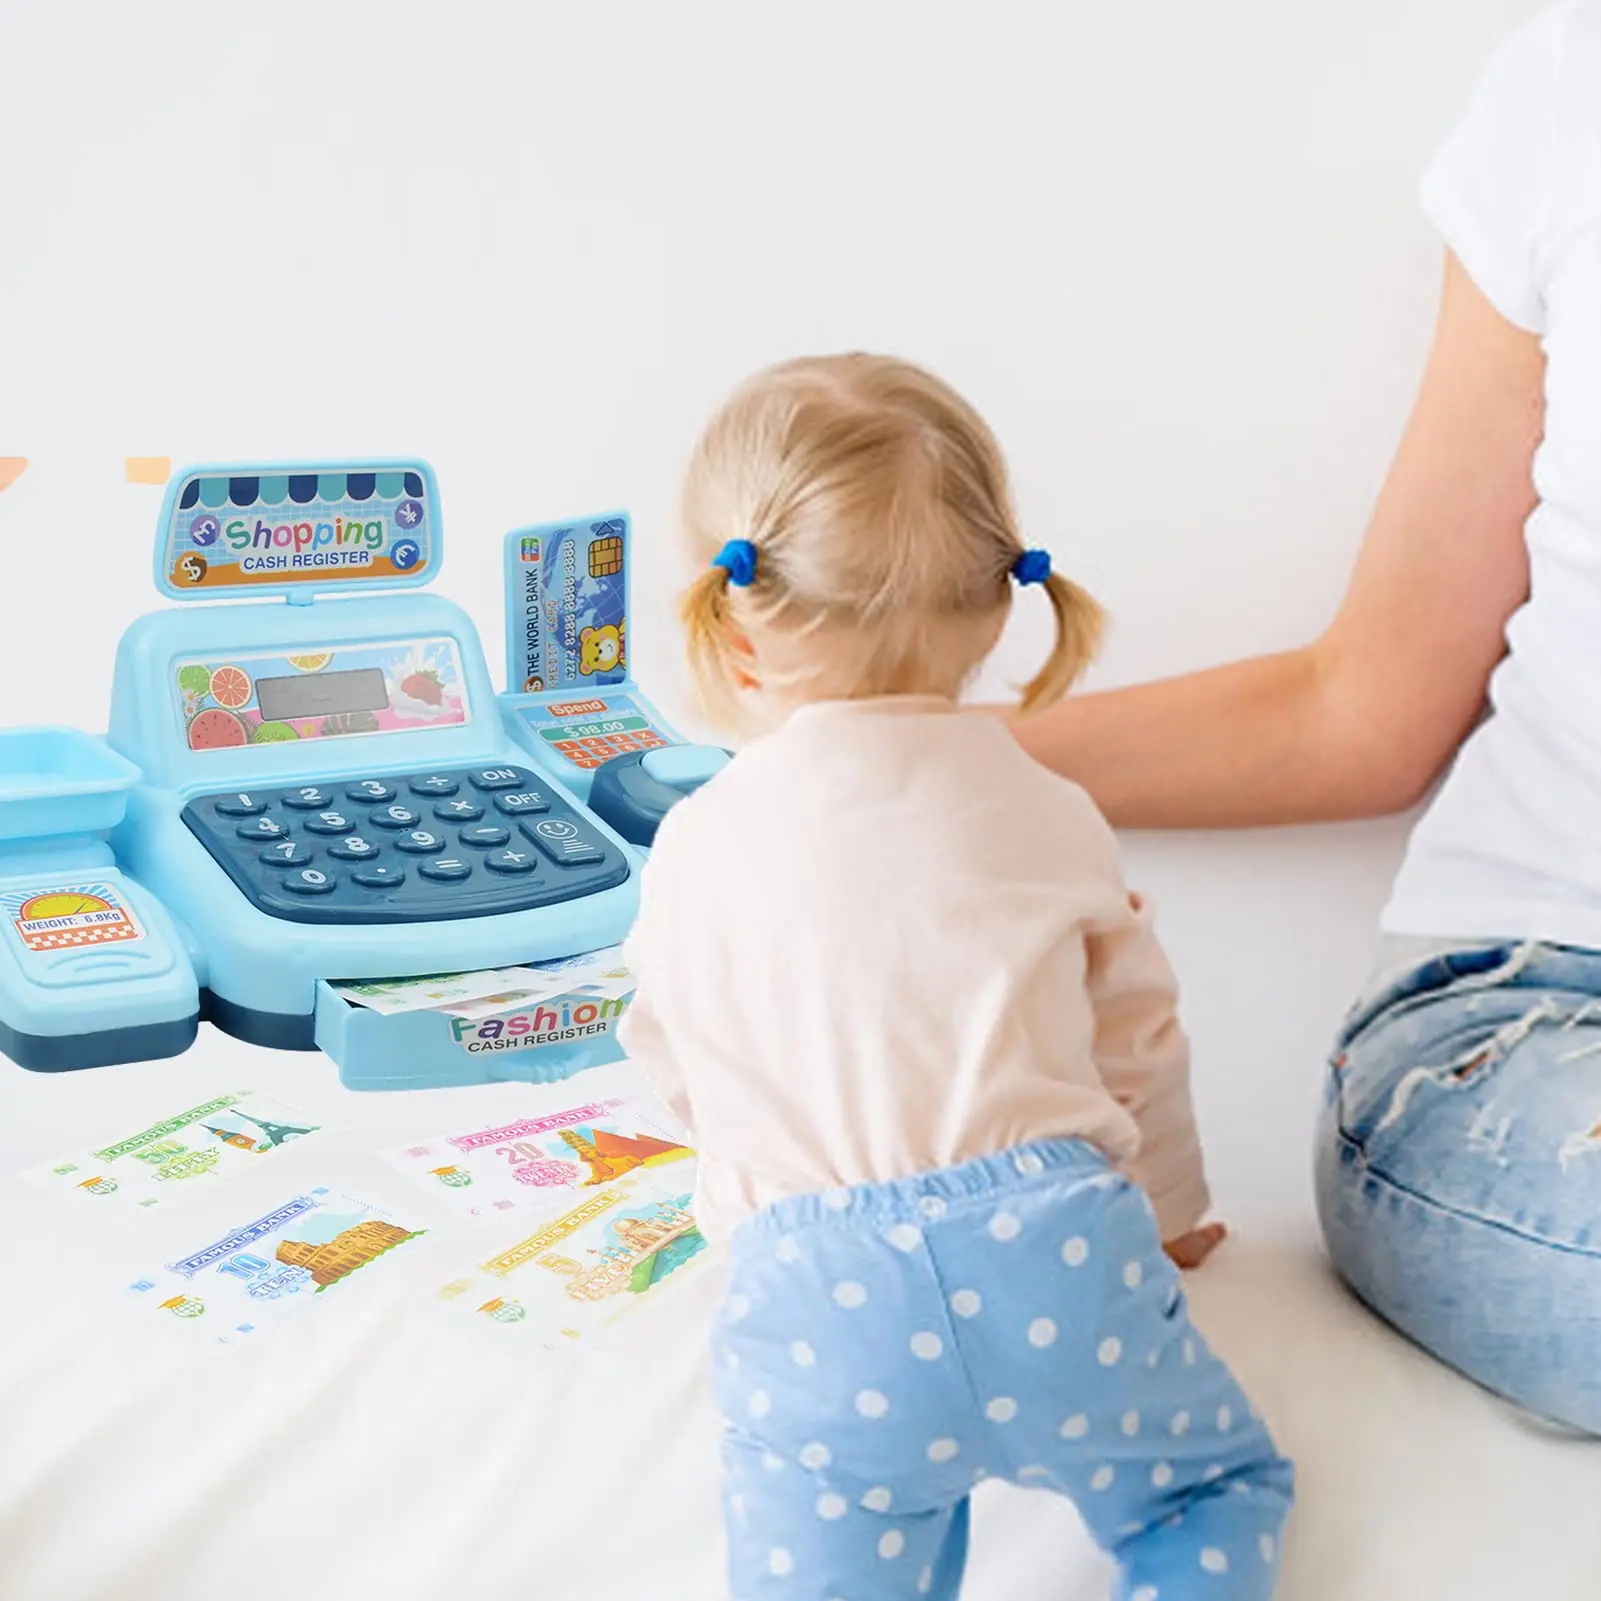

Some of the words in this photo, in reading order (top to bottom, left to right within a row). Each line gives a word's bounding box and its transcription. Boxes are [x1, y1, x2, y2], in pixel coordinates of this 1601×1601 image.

[225, 517, 385, 552] Shopping
[243, 555, 287, 570] CASH
[292, 550, 369, 567] REGISTER
[525, 568, 539, 602] BANK
[526, 603, 540, 652] WORLD
[526, 653, 540, 676] THE
[551, 699, 603, 715] Spend
[563, 721, 625, 738] $98.00
[300, 787, 322, 800] 2
[361, 780, 387, 795] 3
[482, 768, 516, 781] ON
[319, 811, 346, 826] 5
[388, 805, 413, 820] 6
[504, 792, 542, 806] OFF
[276, 841, 297, 858] 7
[344, 836, 371, 852] 8
[411, 831, 436, 846] 9
[23, 917, 79, 931] WEIGHT:
[84, 911, 121, 924] 6.8Kg
[451, 998, 624, 1043] Fashion
[467, 1034, 519, 1053] CASH
[523, 1021, 607, 1046] REGISTER
[112, 1120, 178, 1156] FAMOUS
[180, 1100, 227, 1123] BANK
[471, 1124, 539, 1146] FAMOUS
[542, 1110, 590, 1129] BANK
[495, 1143, 545, 1166] 20
[189, 1231, 256, 1269] FAMOUS
[256, 1204, 302, 1233] BANK
[502, 1226, 567, 1267] FAMOUS
[566, 1196, 609, 1226] BANK
[216, 1253, 271, 1280] 10
[250, 1266, 305, 1297] TEN
